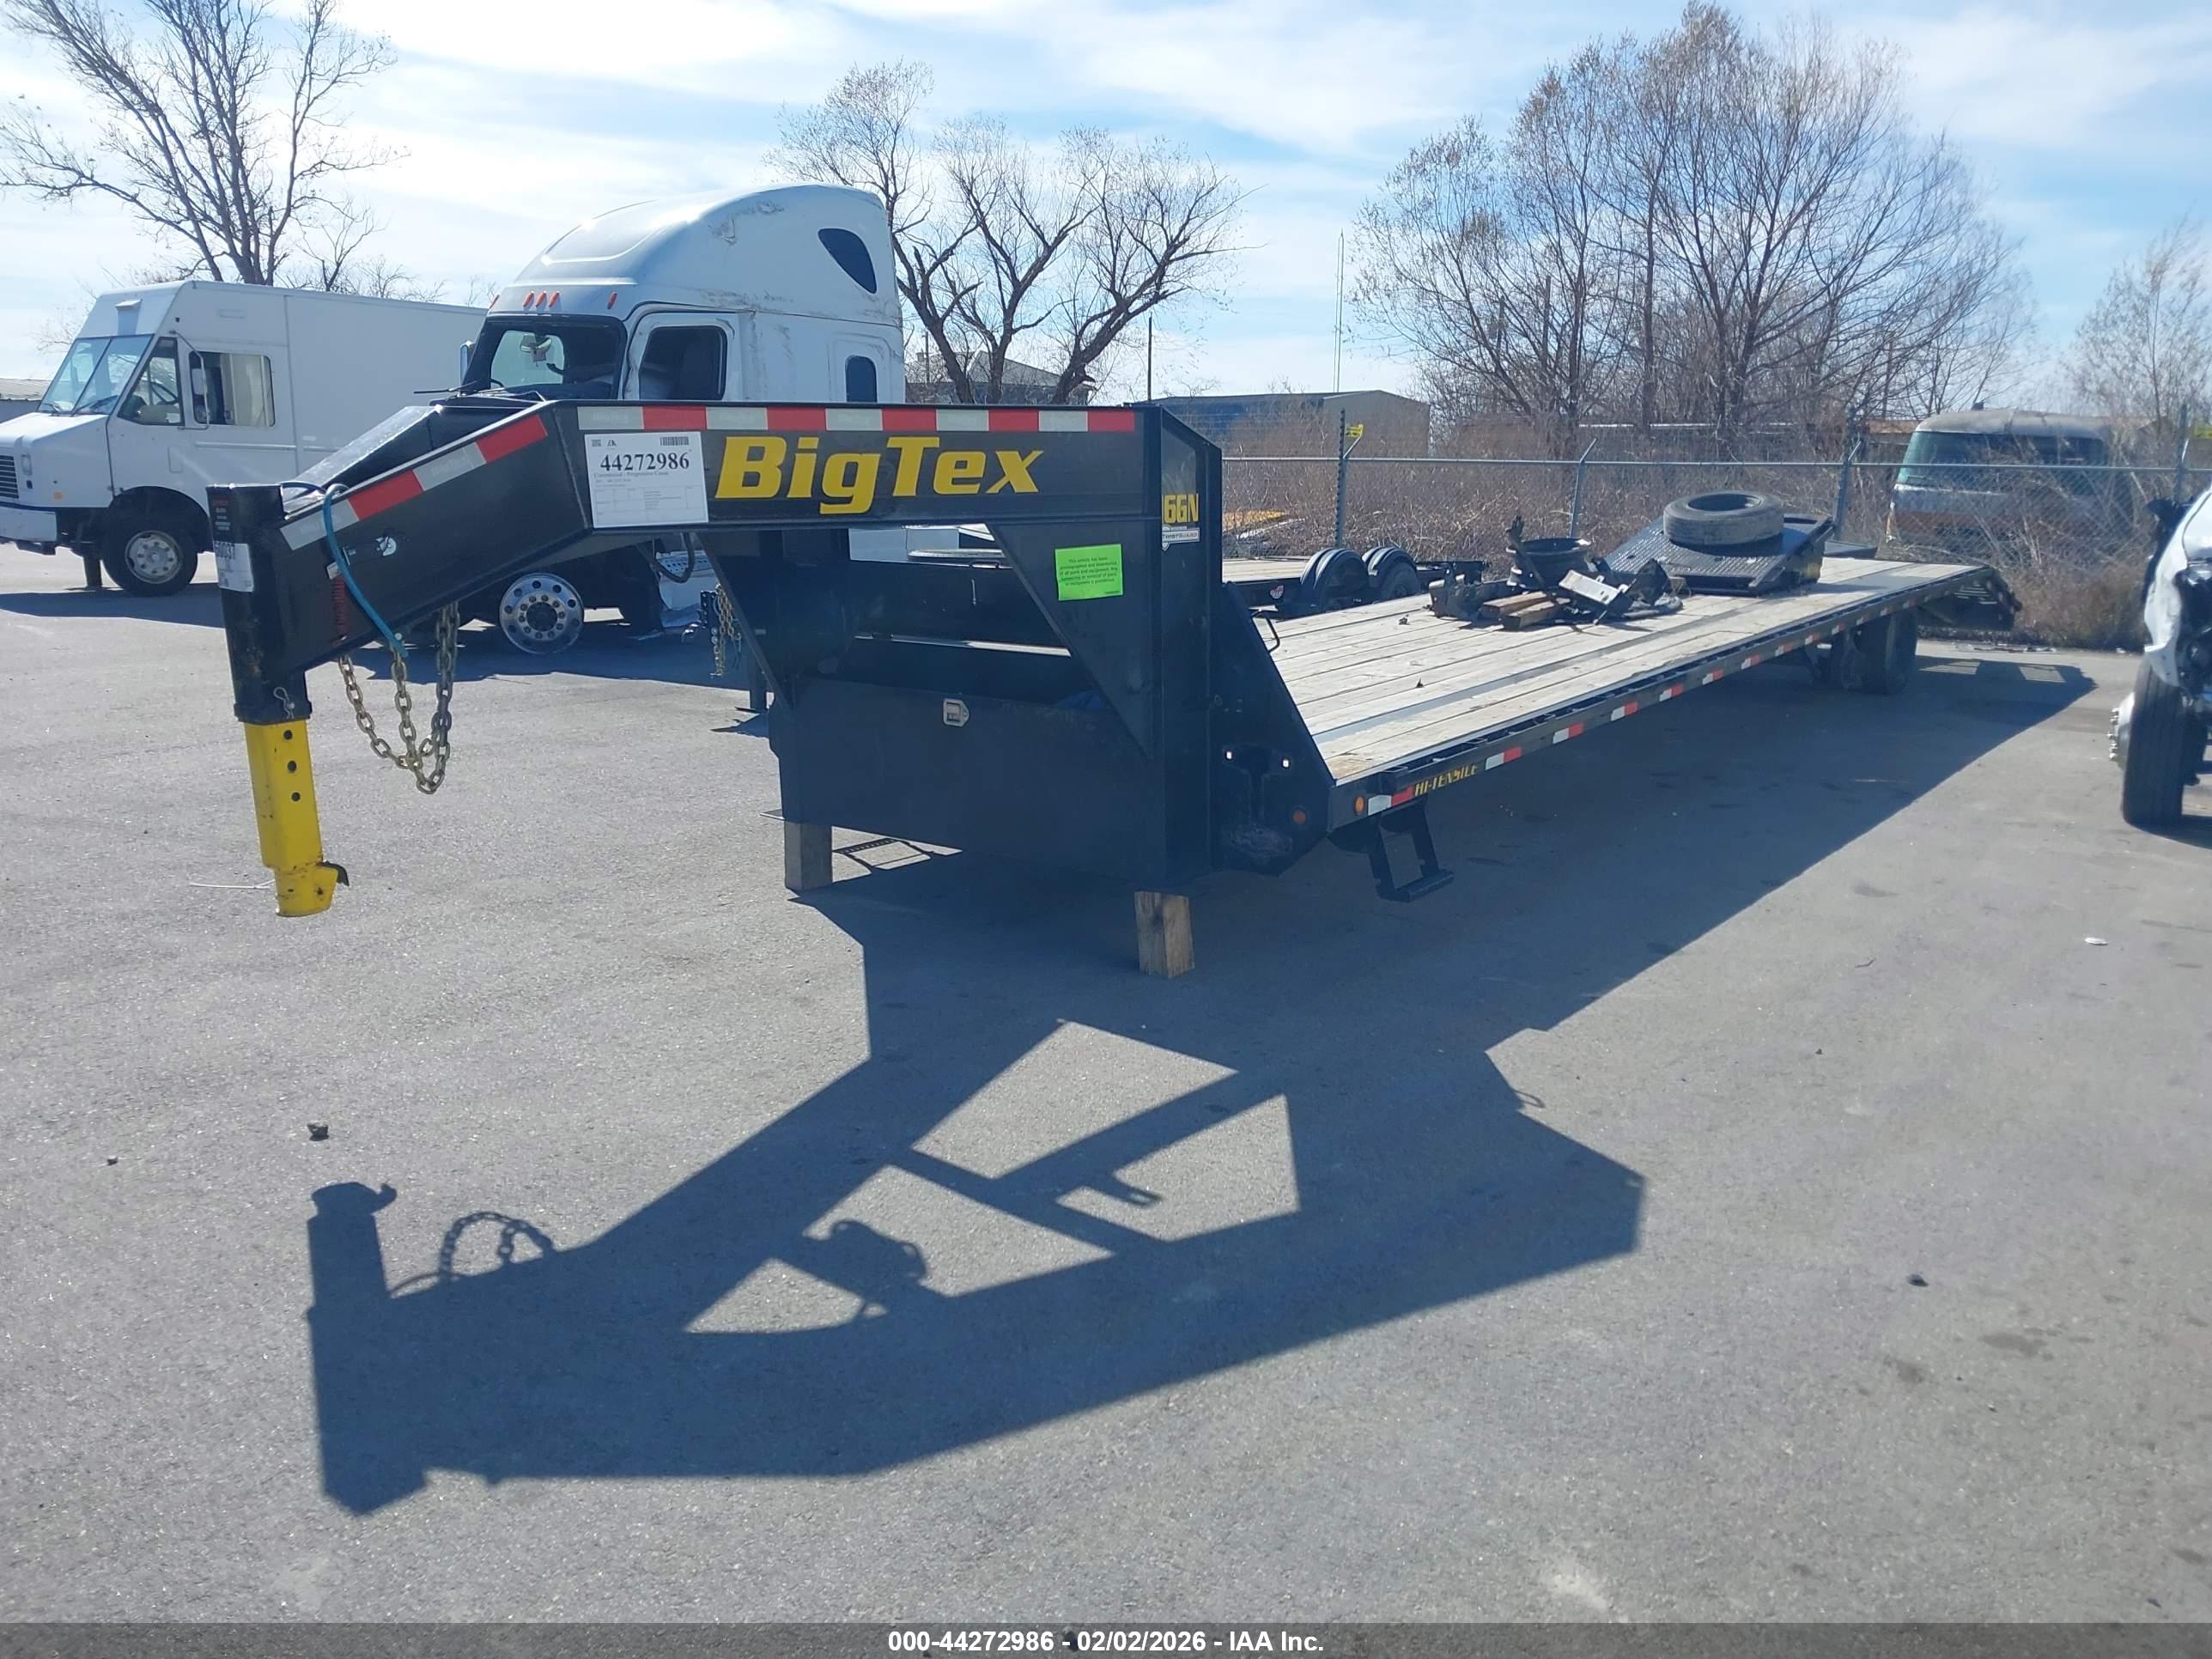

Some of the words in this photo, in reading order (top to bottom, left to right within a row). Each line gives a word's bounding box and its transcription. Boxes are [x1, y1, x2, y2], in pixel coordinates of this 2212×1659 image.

[600, 452, 690, 471] 44272986
[714, 436, 1044, 515] BigTex
[1415, 765, 1478, 796] HI-TENSILE
